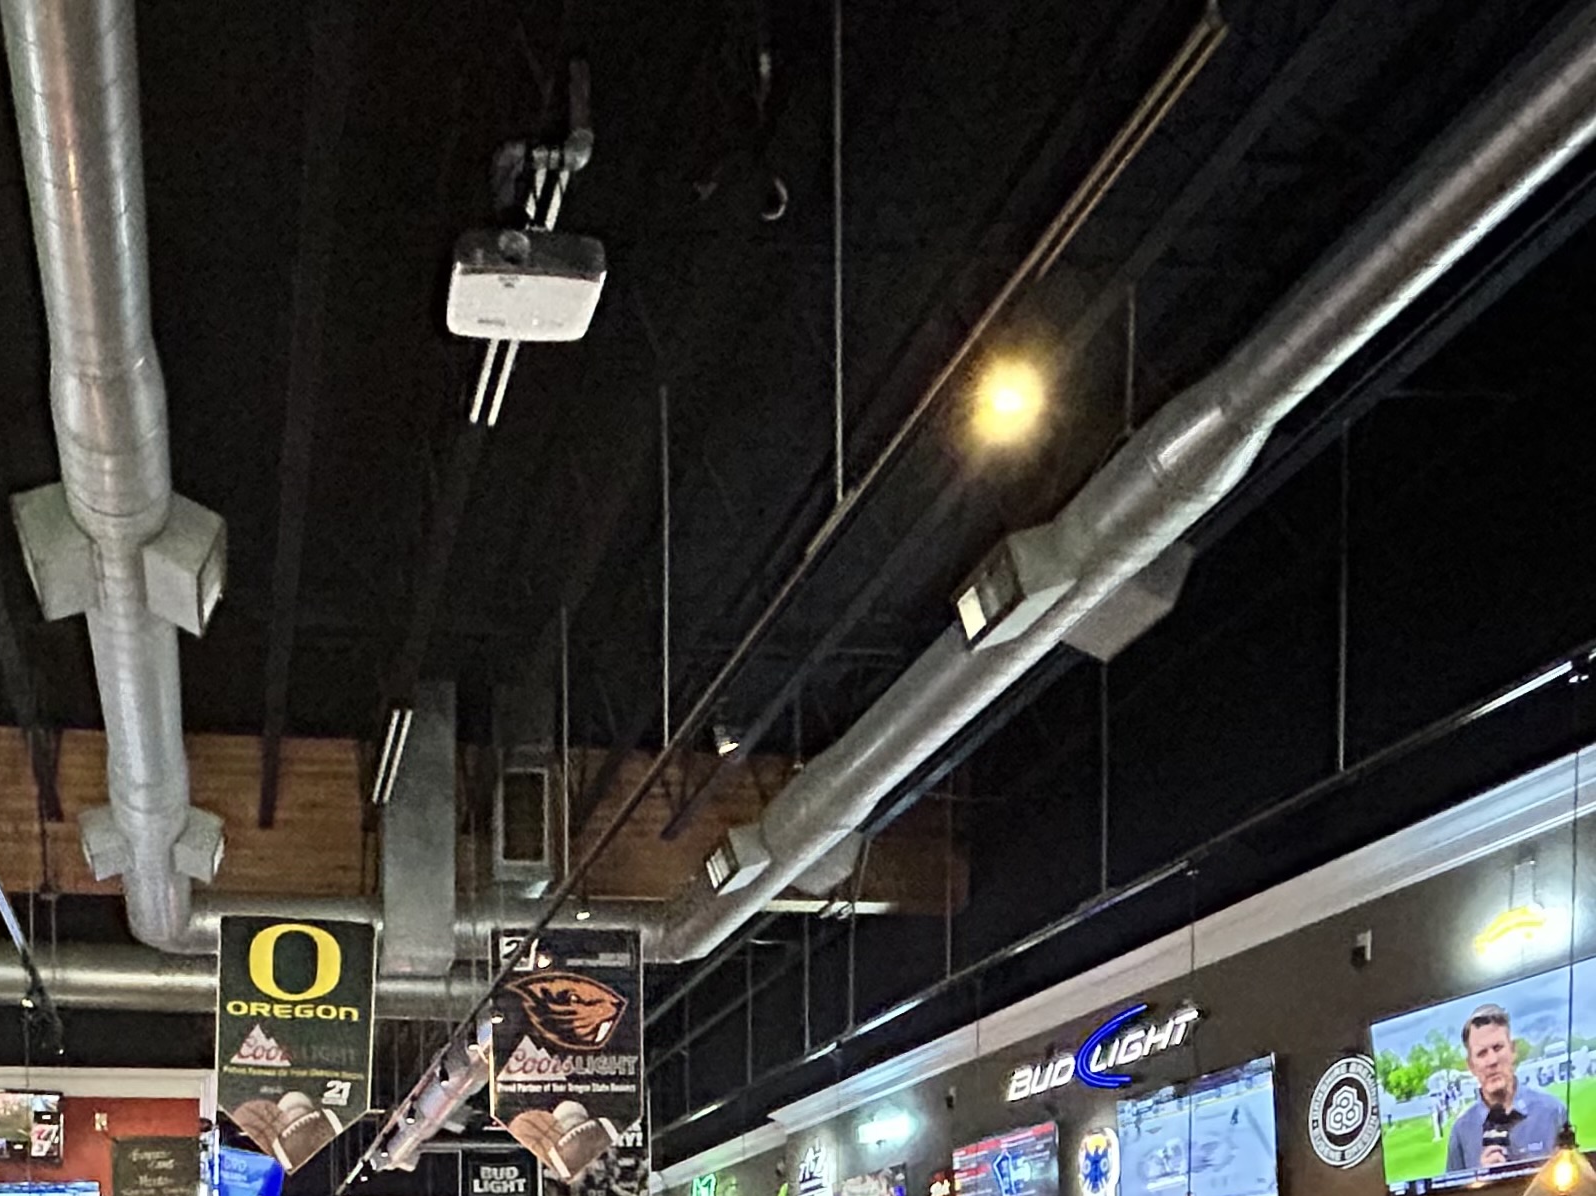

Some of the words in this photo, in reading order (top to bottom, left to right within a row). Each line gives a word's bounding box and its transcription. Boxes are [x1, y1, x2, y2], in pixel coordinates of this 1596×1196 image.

[249, 923, 342, 1000] O
[226, 1000, 360, 1022] OREGON
[506, 1050, 574, 1077] Coors
[574, 1055, 639, 1076] LIGHT
[1007, 1054, 1076, 1102] BUD
[1089, 1008, 1200, 1073] LIGHT
[323, 1080, 352, 1100] 21
[480, 1166, 519, 1180] BUD
[473, 1178, 527, 1193] LIGHT
